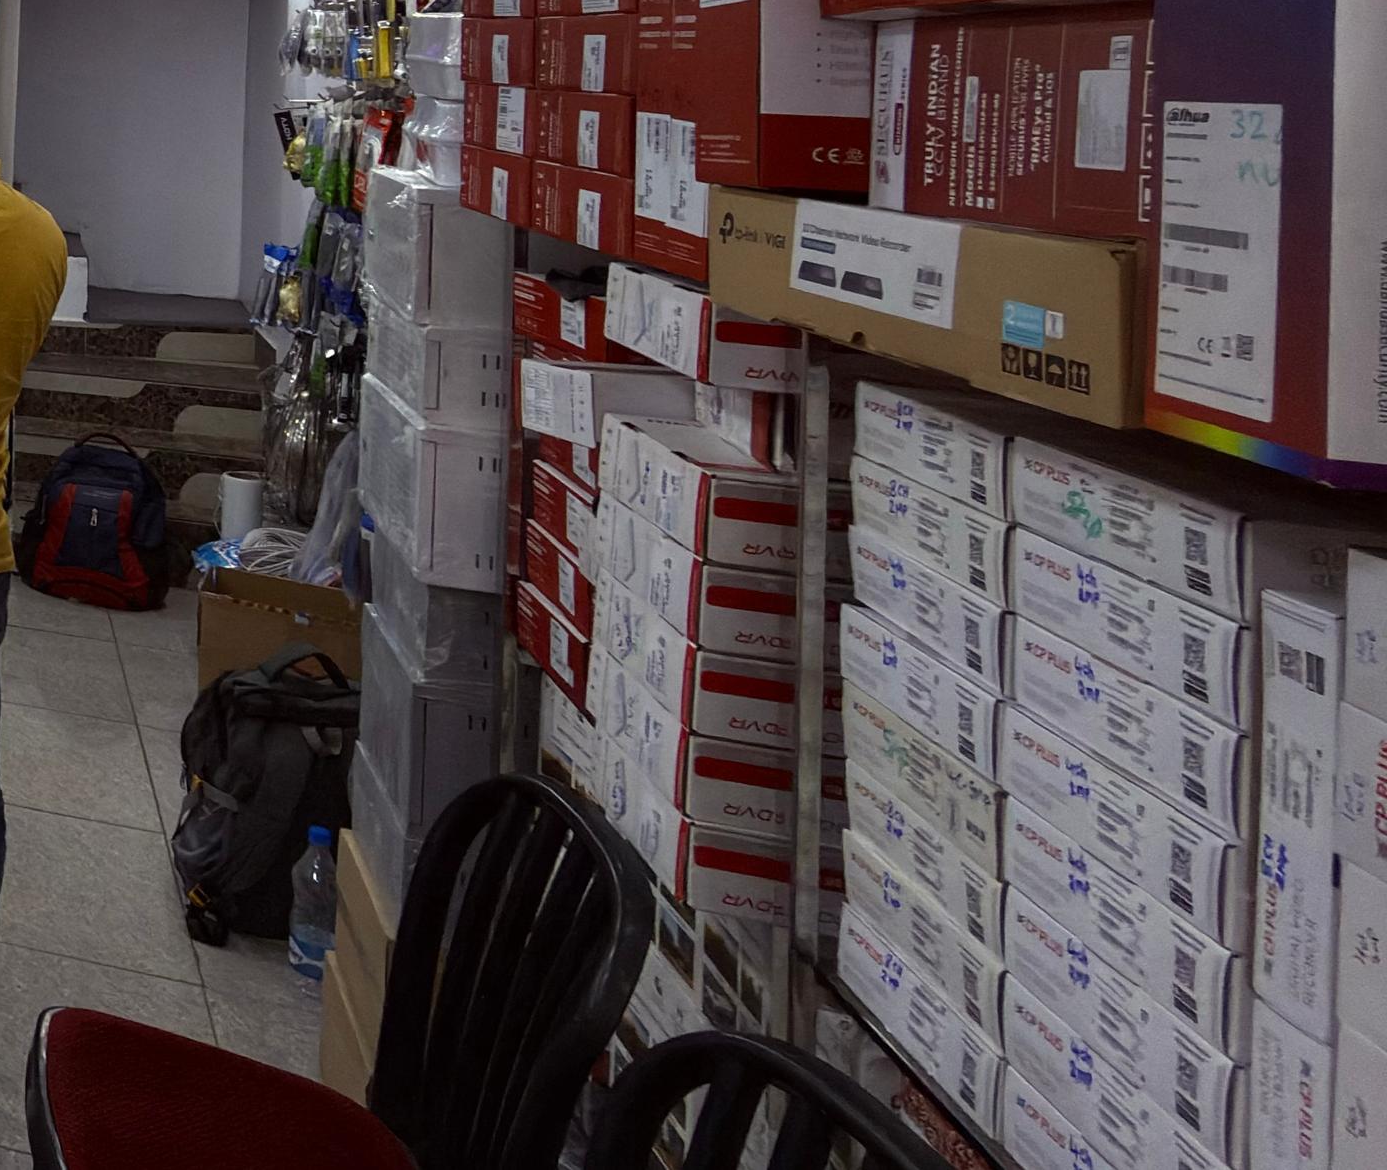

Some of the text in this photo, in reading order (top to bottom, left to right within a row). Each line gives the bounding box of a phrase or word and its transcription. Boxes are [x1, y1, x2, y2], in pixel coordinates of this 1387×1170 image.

[923, 44, 941, 186] TRULY INDIAN
[934, 54, 950, 177] CCTV BRAND
[949, 27, 965, 206] NETWORK VIDEO RECORDER
[1042, 112, 1053, 163] Android
[965, 144, 975, 206] Models
[1047, 465, 1070, 485] PLUS
[1046, 559, 1071, 581] PLUS
[1047, 651, 1071, 674] PLUS
[1035, 741, 1060, 768] PLUS
[1036, 834, 1063, 862] PLUS
[1298, 1080, 1313, 1159] CP PLUS
